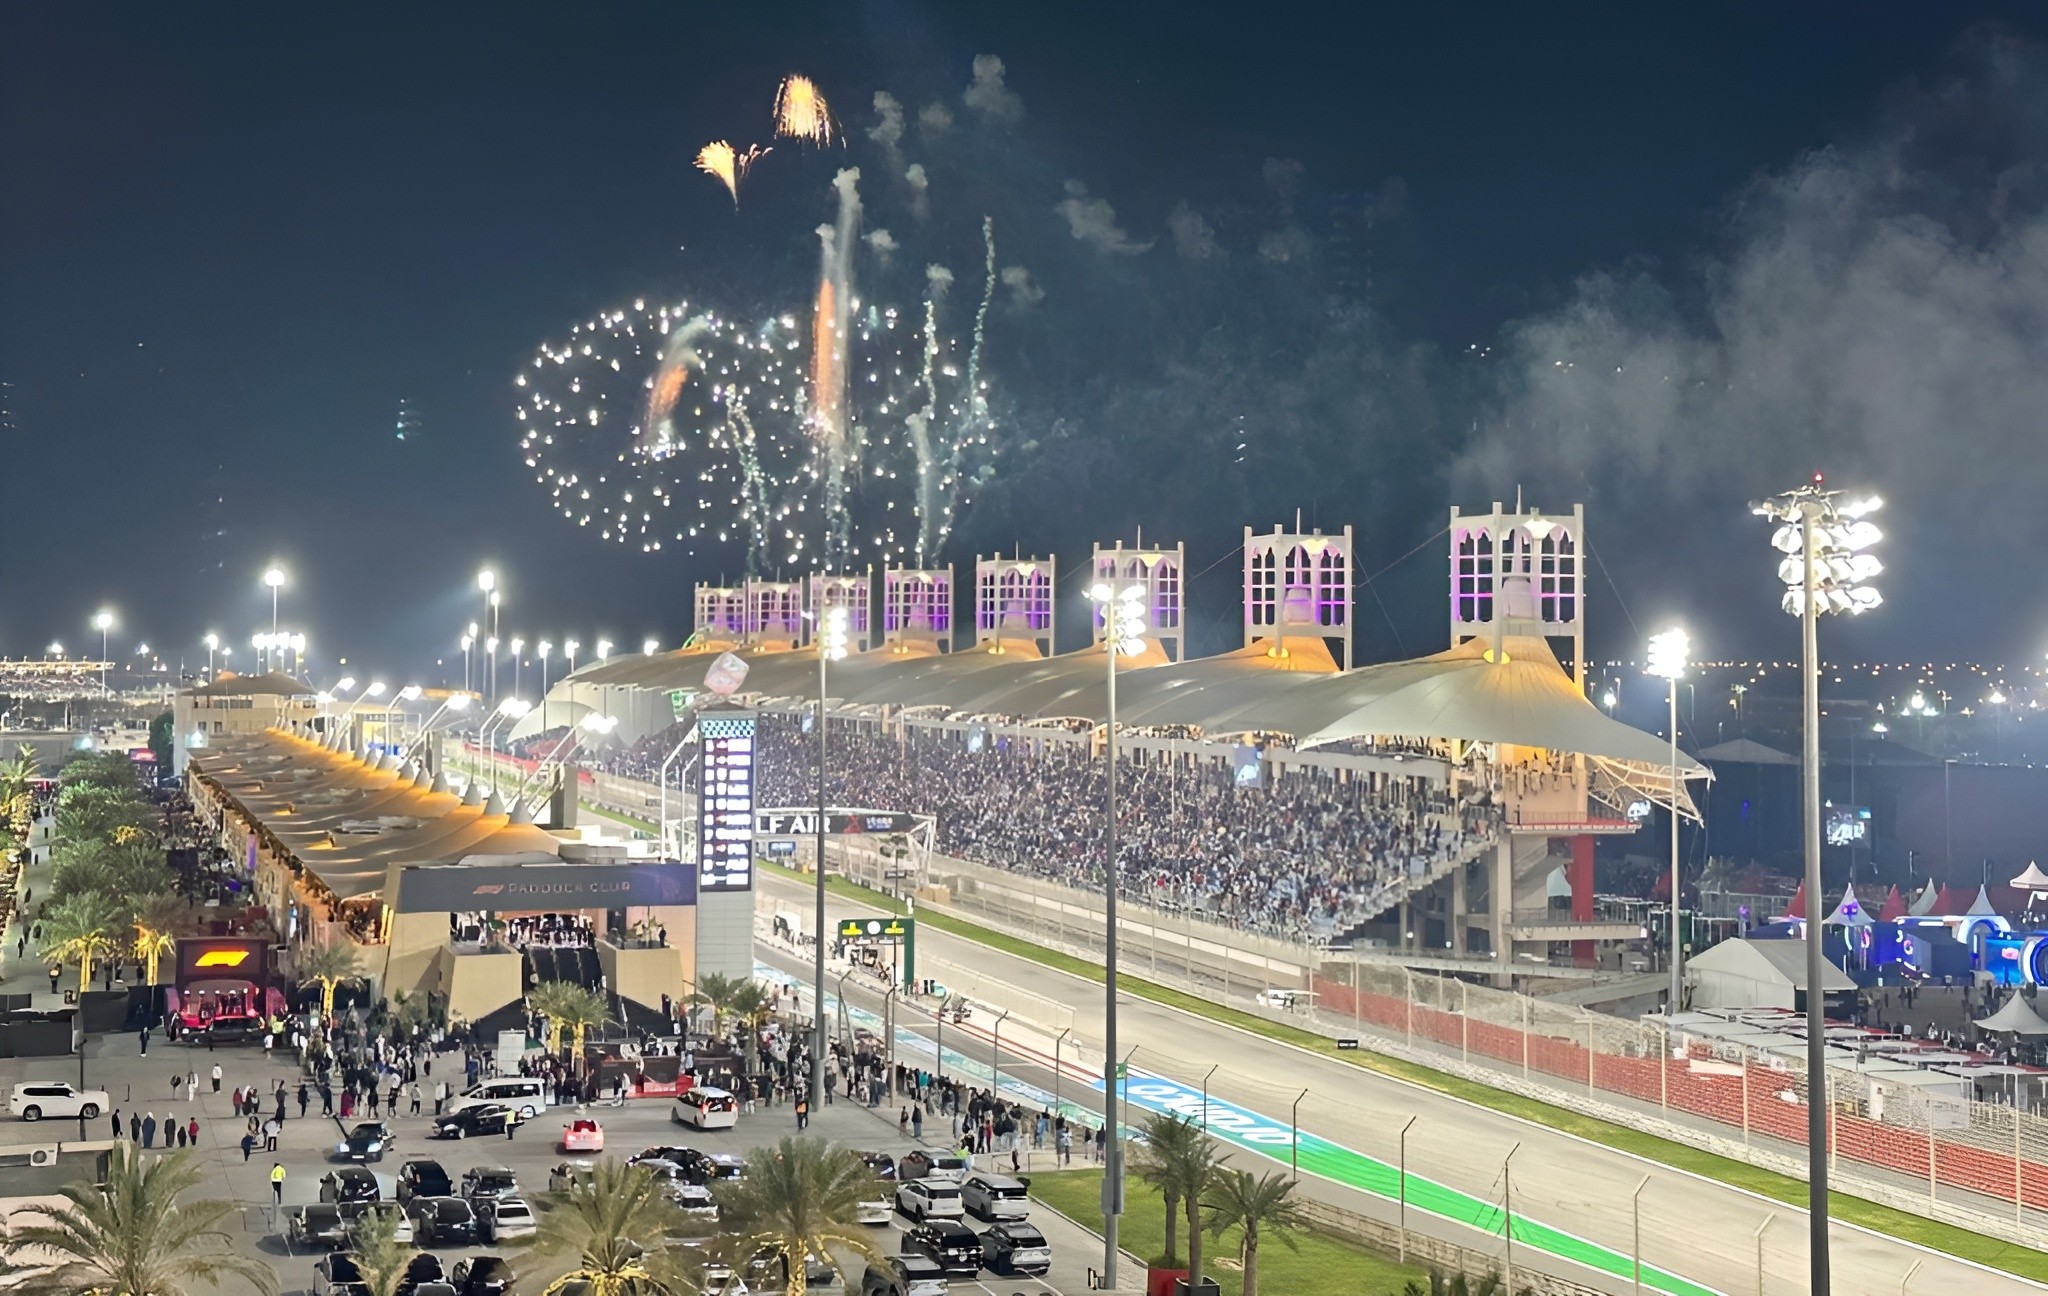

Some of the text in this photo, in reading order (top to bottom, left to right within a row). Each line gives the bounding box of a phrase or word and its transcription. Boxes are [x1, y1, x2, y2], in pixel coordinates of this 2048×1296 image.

[790, 815, 831, 834] AIR
[508, 882, 583, 895] PADDOCK
[589, 881, 631, 893] CLUB
